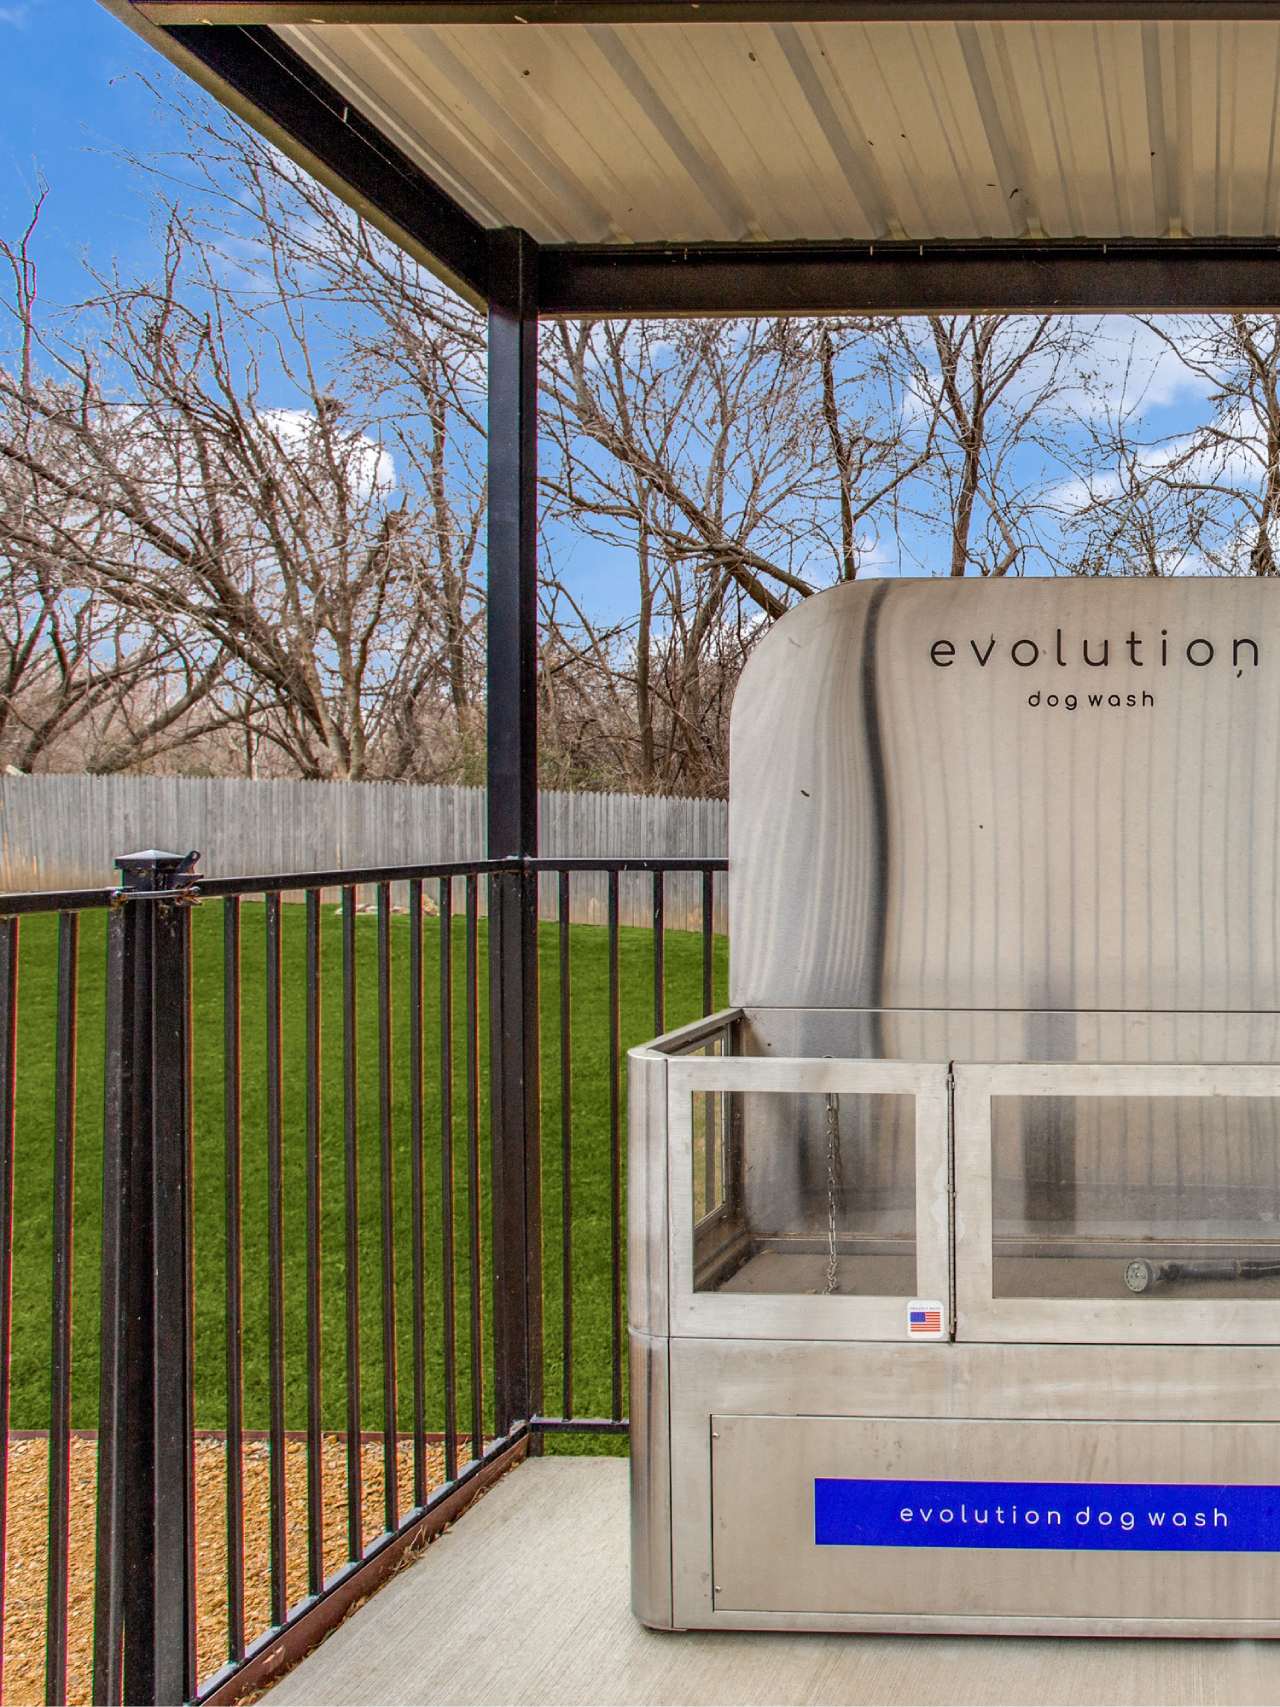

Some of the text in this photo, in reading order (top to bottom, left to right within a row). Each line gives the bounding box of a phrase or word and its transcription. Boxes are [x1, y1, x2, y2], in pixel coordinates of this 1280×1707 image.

[930, 628, 1259, 667] evolution
[1028, 691, 1154, 711] dog wash
[900, 1505, 1229, 1531] evolution dog wash
